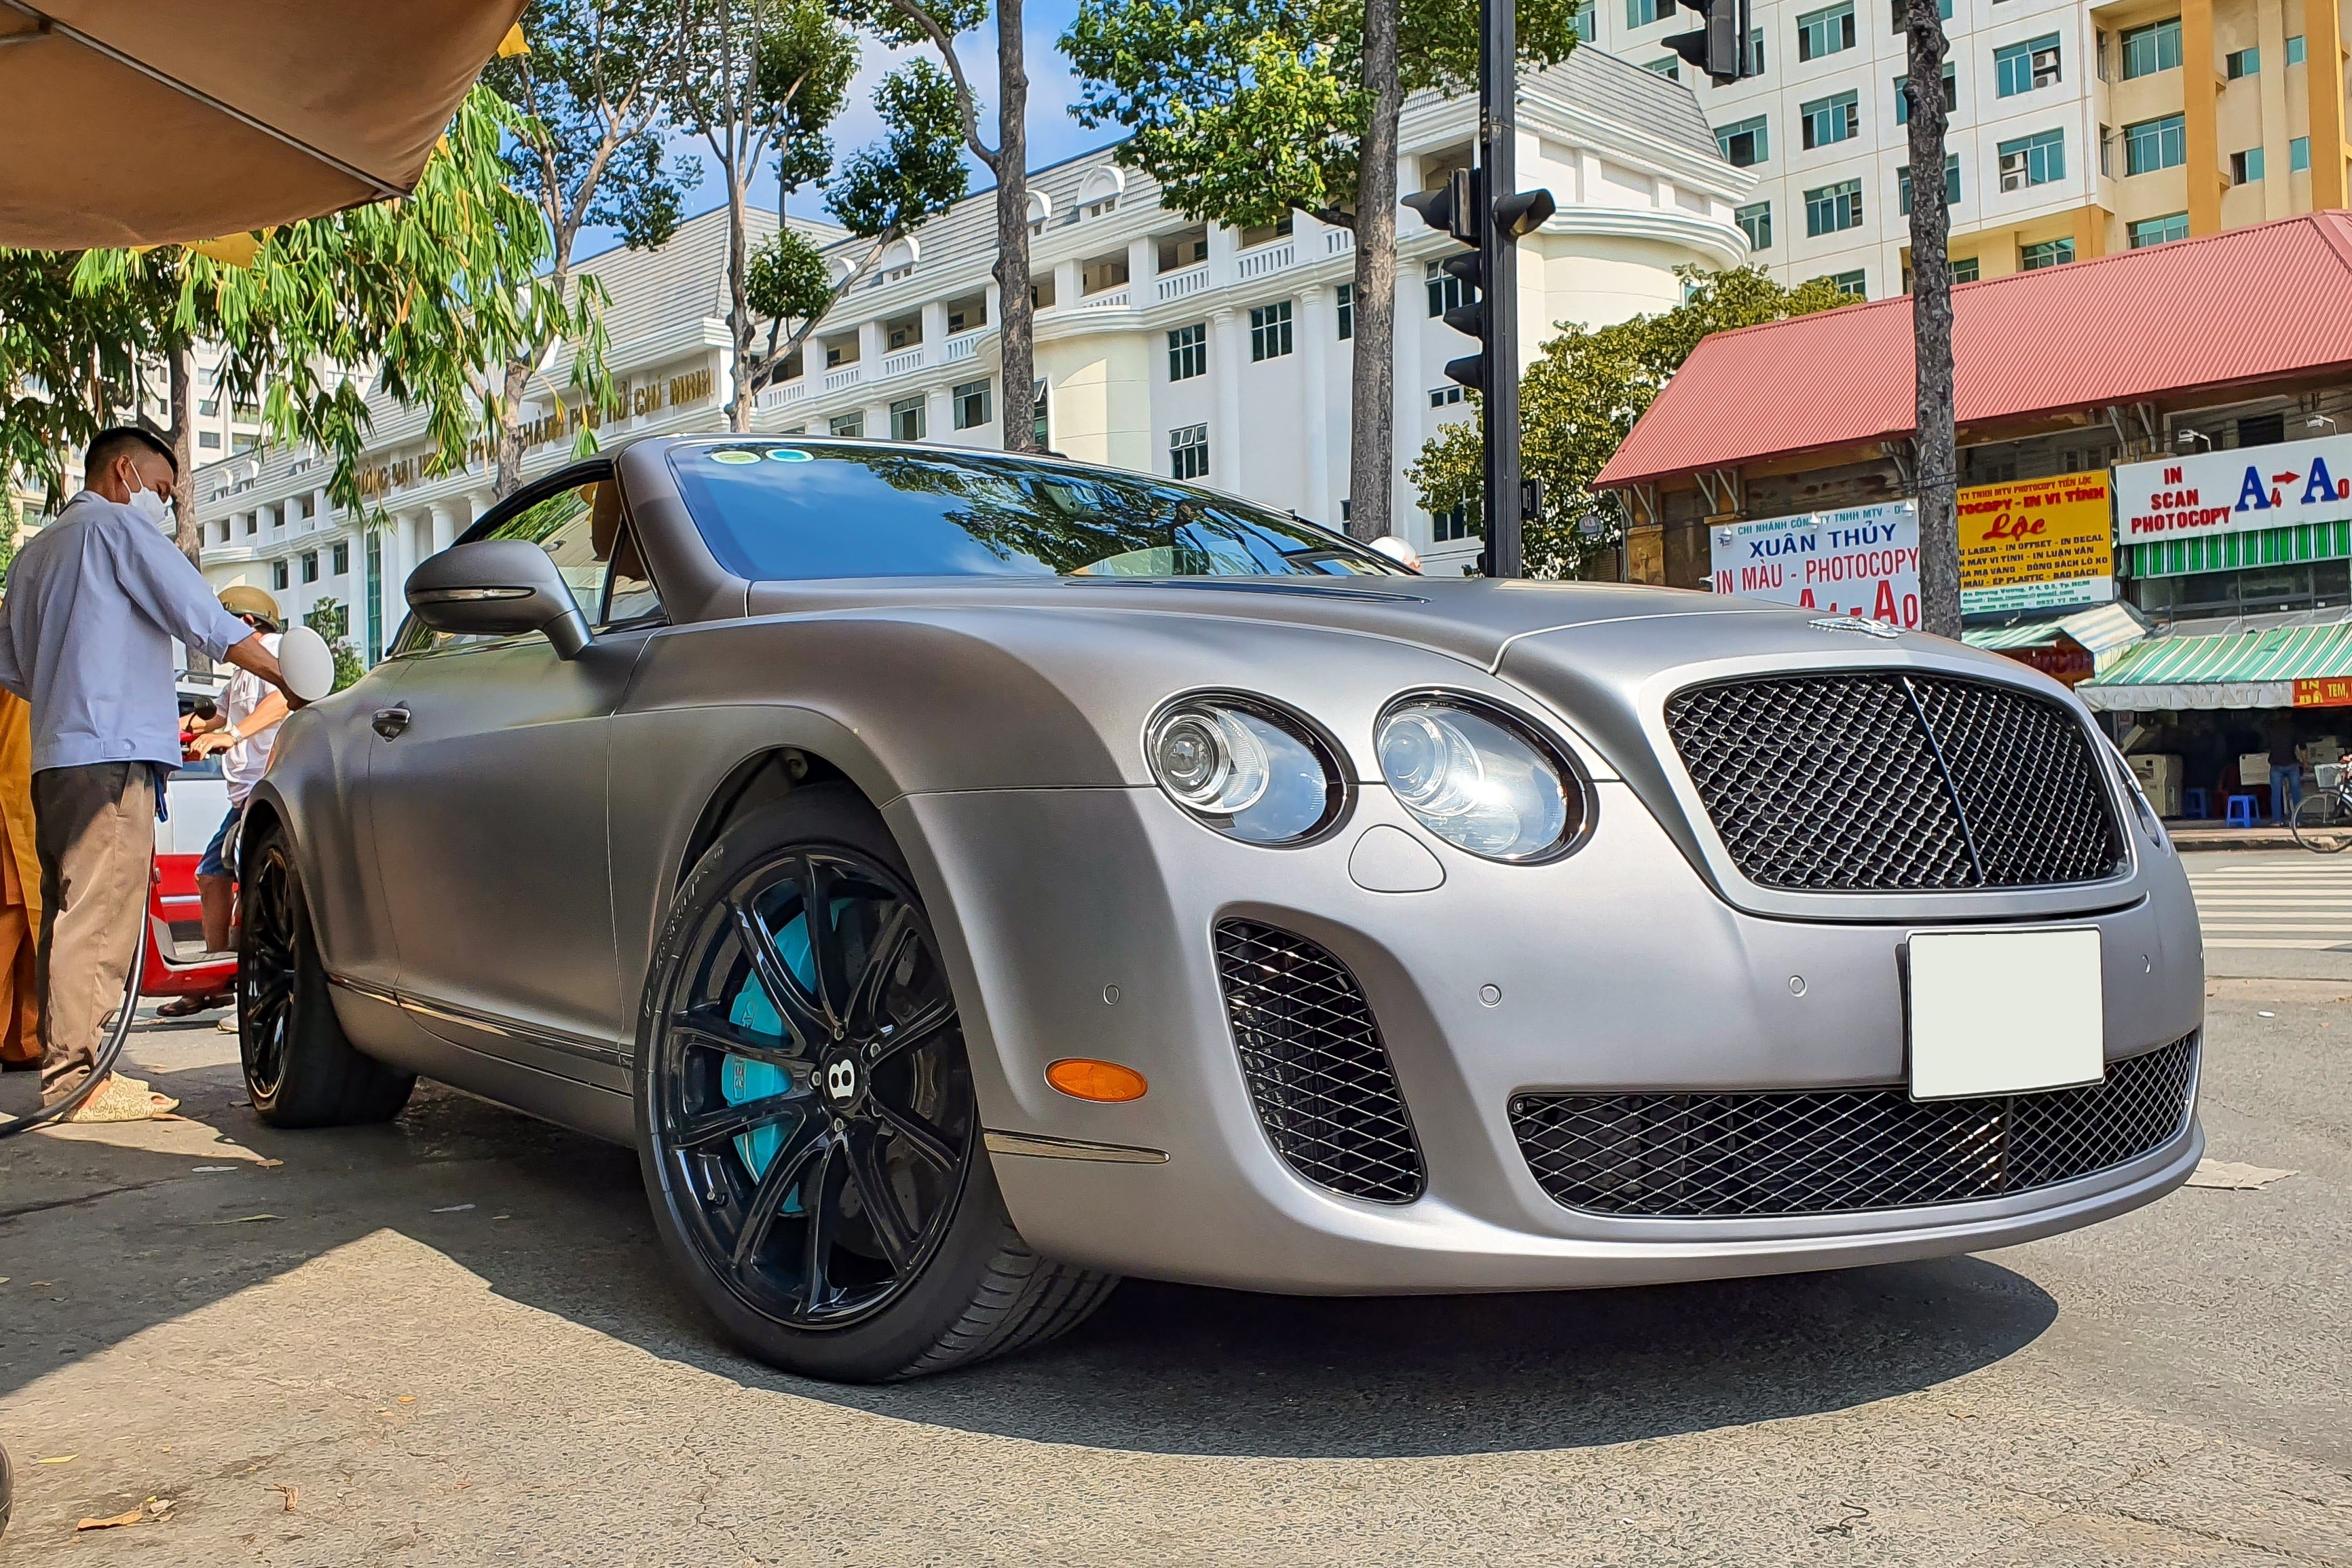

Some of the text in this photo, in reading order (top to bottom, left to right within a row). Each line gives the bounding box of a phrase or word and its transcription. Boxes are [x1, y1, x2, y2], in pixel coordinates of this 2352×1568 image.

[669, 367, 714, 405] MINH
[2164, 466, 2183, 485] IN
[1957, 499, 2013, 516] TOCOPY
[2023, 495, 2041, 508] IN
[2045, 492, 2061, 505] VI
[2065, 486, 2104, 502] TÍNH
[1971, 489, 1992, 499] TNHH
[1994, 487, 2011, 496] MTV
[2014, 481, 2055, 493] PHOTOCOPY
[2150, 489, 2199, 510] SCAN
[1738, 523, 1753, 536] CHI
[1756, 519, 1787, 532] NHÁNH
[1790, 516, 1811, 529] CÔN
[1833, 512, 1859, 523] TNHH
[1863, 507, 1883, 519] MTV
[1982, 513, 2047, 542] Lộc
[2131, 506, 2231, 534] PHOTOCOPY
[1749, 521, 1897, 559] XUÂN THỦY
[2074, 534, 2104, 544] DECAL
[1716, 569, 1734, 595] IN
[1742, 559, 1783, 592] MÀU
[1806, 547, 1920, 584] PHOTOCOPY
[2000, 553, 2024, 563] TÍNH
[2006, 574, 2044, 584] PLASTIC
[2053, 571, 2072, 579] BAO
